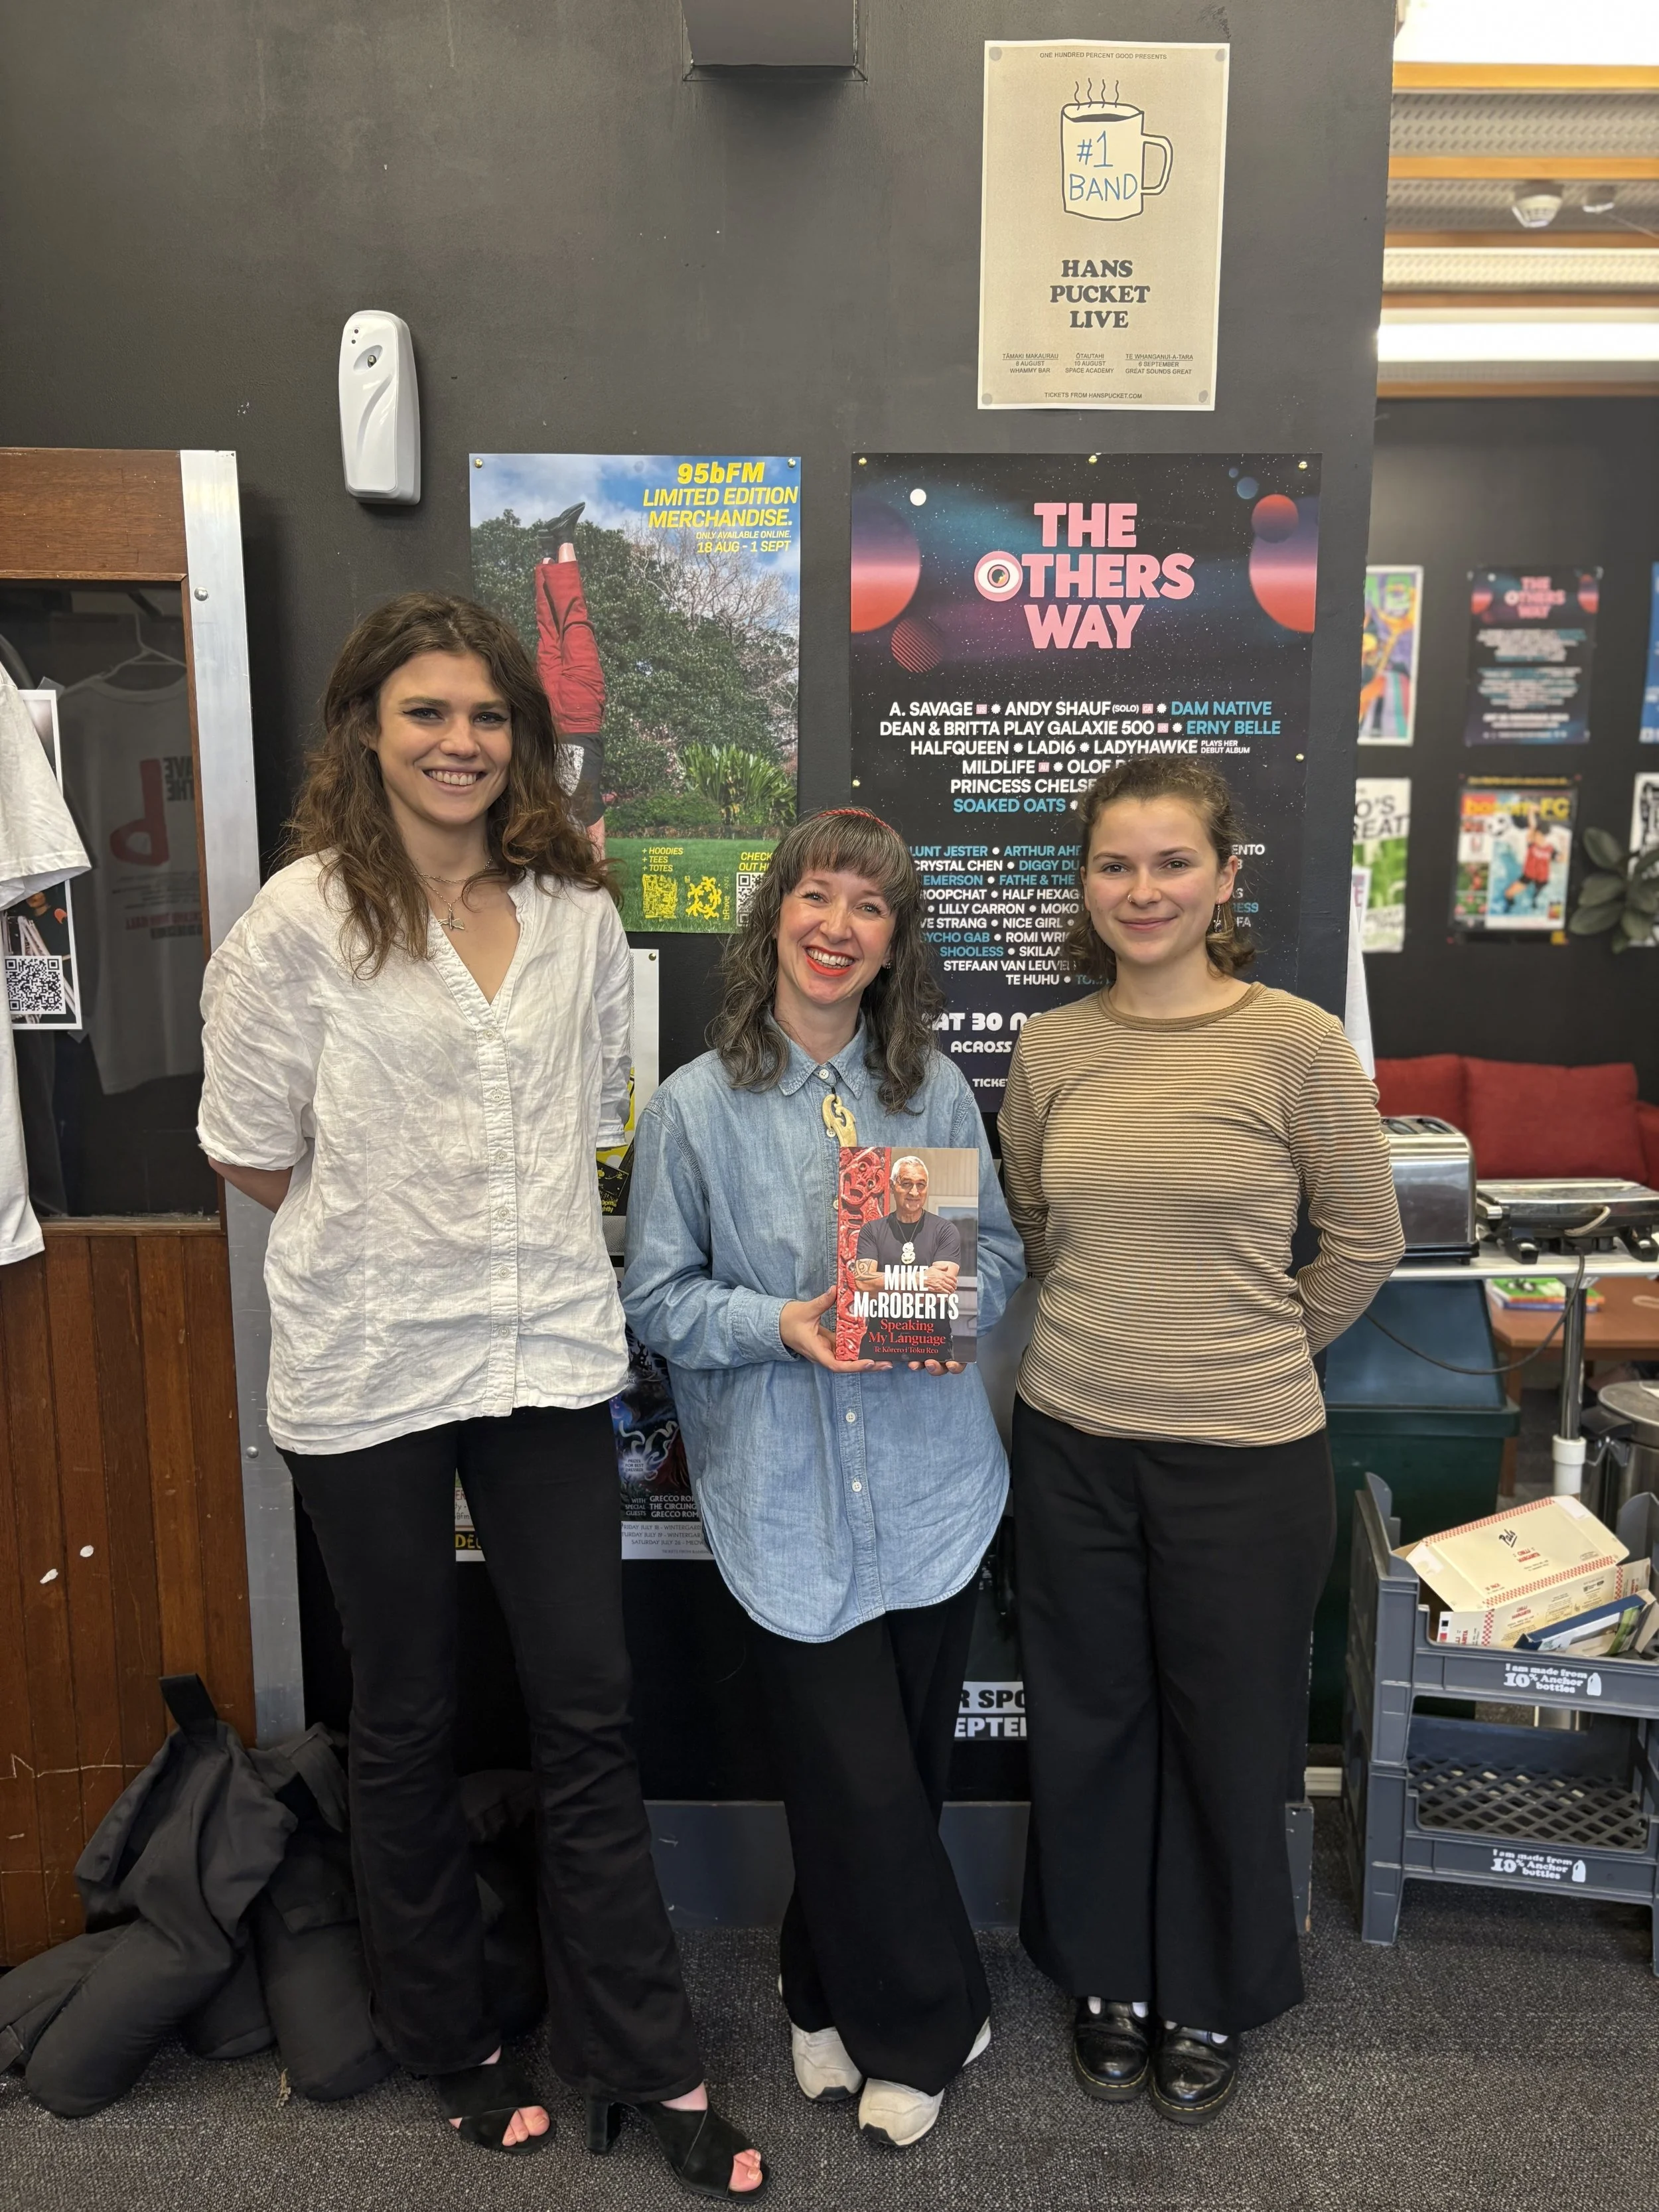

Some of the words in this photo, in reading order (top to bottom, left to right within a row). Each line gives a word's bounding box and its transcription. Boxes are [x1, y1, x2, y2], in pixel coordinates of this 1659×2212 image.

[1077, 131, 1113, 168] #1
[1069, 173, 1138, 201] BAND
[1061, 260, 1133, 278] HANS
[1050, 285, 1150, 303] PUCKET
[1070, 311, 1129, 329] LIVE
[677, 461, 765, 484] 95bFM
[643, 488, 719, 506] LIMITED
[723, 486, 798, 505] EDITION
[648, 509, 792, 528] MERCHANDISE.
[1034, 502, 1137, 548] THE
[697, 542, 712, 553] 18
[715, 542, 739, 552] AUG
[751, 542, 757, 552] 1
[760, 541, 791, 552] SEPT
[974, 551, 1195, 601] OTHERS
[1023, 604, 1145, 649] WAY
[889, 702, 905, 715] A.
[909, 701, 973, 715] SAVAGE
[1005, 701, 1052, 715] ANDY
[1055, 701, 1111, 715] SHAUF
[1112, 704, 1139, 714] (SOLO)
[1171, 701, 1208, 715] DAM
[1213, 701, 1272, 715] NATIVE
[880, 721, 925, 735] DEAN
[928, 721, 940, 735] &
[944, 721, 1000, 735] BRITTA
[1004, 721, 1044, 735] PLAY
[1047, 721, 1118, 735] GALAXIE
[1121, 721, 1154, 735] 500
[1187, 721, 1230, 735] ERNY
[1234, 721, 1281, 734] BELLE
[910, 741, 1009, 755] HALFQUEEN
[1028, 741, 1075, 754] LADI6
[1094, 740, 1197, 754] LADYHAWKE
[962, 760, 1035, 774] MILDLIFE
[1067, 760, 1112, 774] OLOF
[951, 780, 1031, 793] PRINCESS
[953, 798, 1019, 812] SOAKED
[1024, 798, 1066, 812] OATS
[741, 852, 772, 861] CHECK
[944, 846, 987, 857] JESTER
[1004, 846, 1054, 856] ARTHUR
[914, 860, 965, 871] CRYSTAL
[967, 860, 1002, 871] CHEN
[1019, 860, 1058, 871] DIGGY
[923, 875, 983, 885] EMERSON
[999, 875, 1037, 885] FATHE
[1039, 875, 1048, 885] &
[1051, 875, 1075, 885] THE
[1003, 889, 1034, 900] HALF
[939, 904, 969, 915] LILLY
[972, 904, 1025, 914] CARRON
[1041, 903, 1078, 914] MOKO
[936, 918, 987, 928] STRANG
[1003, 918, 1032, 928] NICE
[1035, 918, 1062, 928] GIRL
[964, 932, 989, 942] GAB
[1006, 932, 1038, 942] ROMI
[940, 946, 1003, 957] SHOOLESS
[944, 960, 997, 971] STEFAAN
[1001, 960, 1025, 971] VAN
[1006, 975, 1020, 985] TE
[1023, 975, 1059, 985] HUHU
[972, 1013, 1003, 1031] 30
[951, 1041, 1013, 1053] ACROSS
[885, 1264, 929, 1291] MIKE
[854, 1291, 959, 1320] McROBERTS
[881, 1319, 934, 1333] Speaking
[869, 1331, 887, 1345] My
[890, 1332, 946, 1346] Language
[1540, 1674, 1583, 1686] Anchor
[1561, 1668, 1587, 1678] from
[1536, 1682, 1575, 1693] bottles
[1527, 1861, 1568, 1873] Anchor
[1546, 1856, 1573, 1866] from
[1522, 1868, 1560, 1880] bottles
